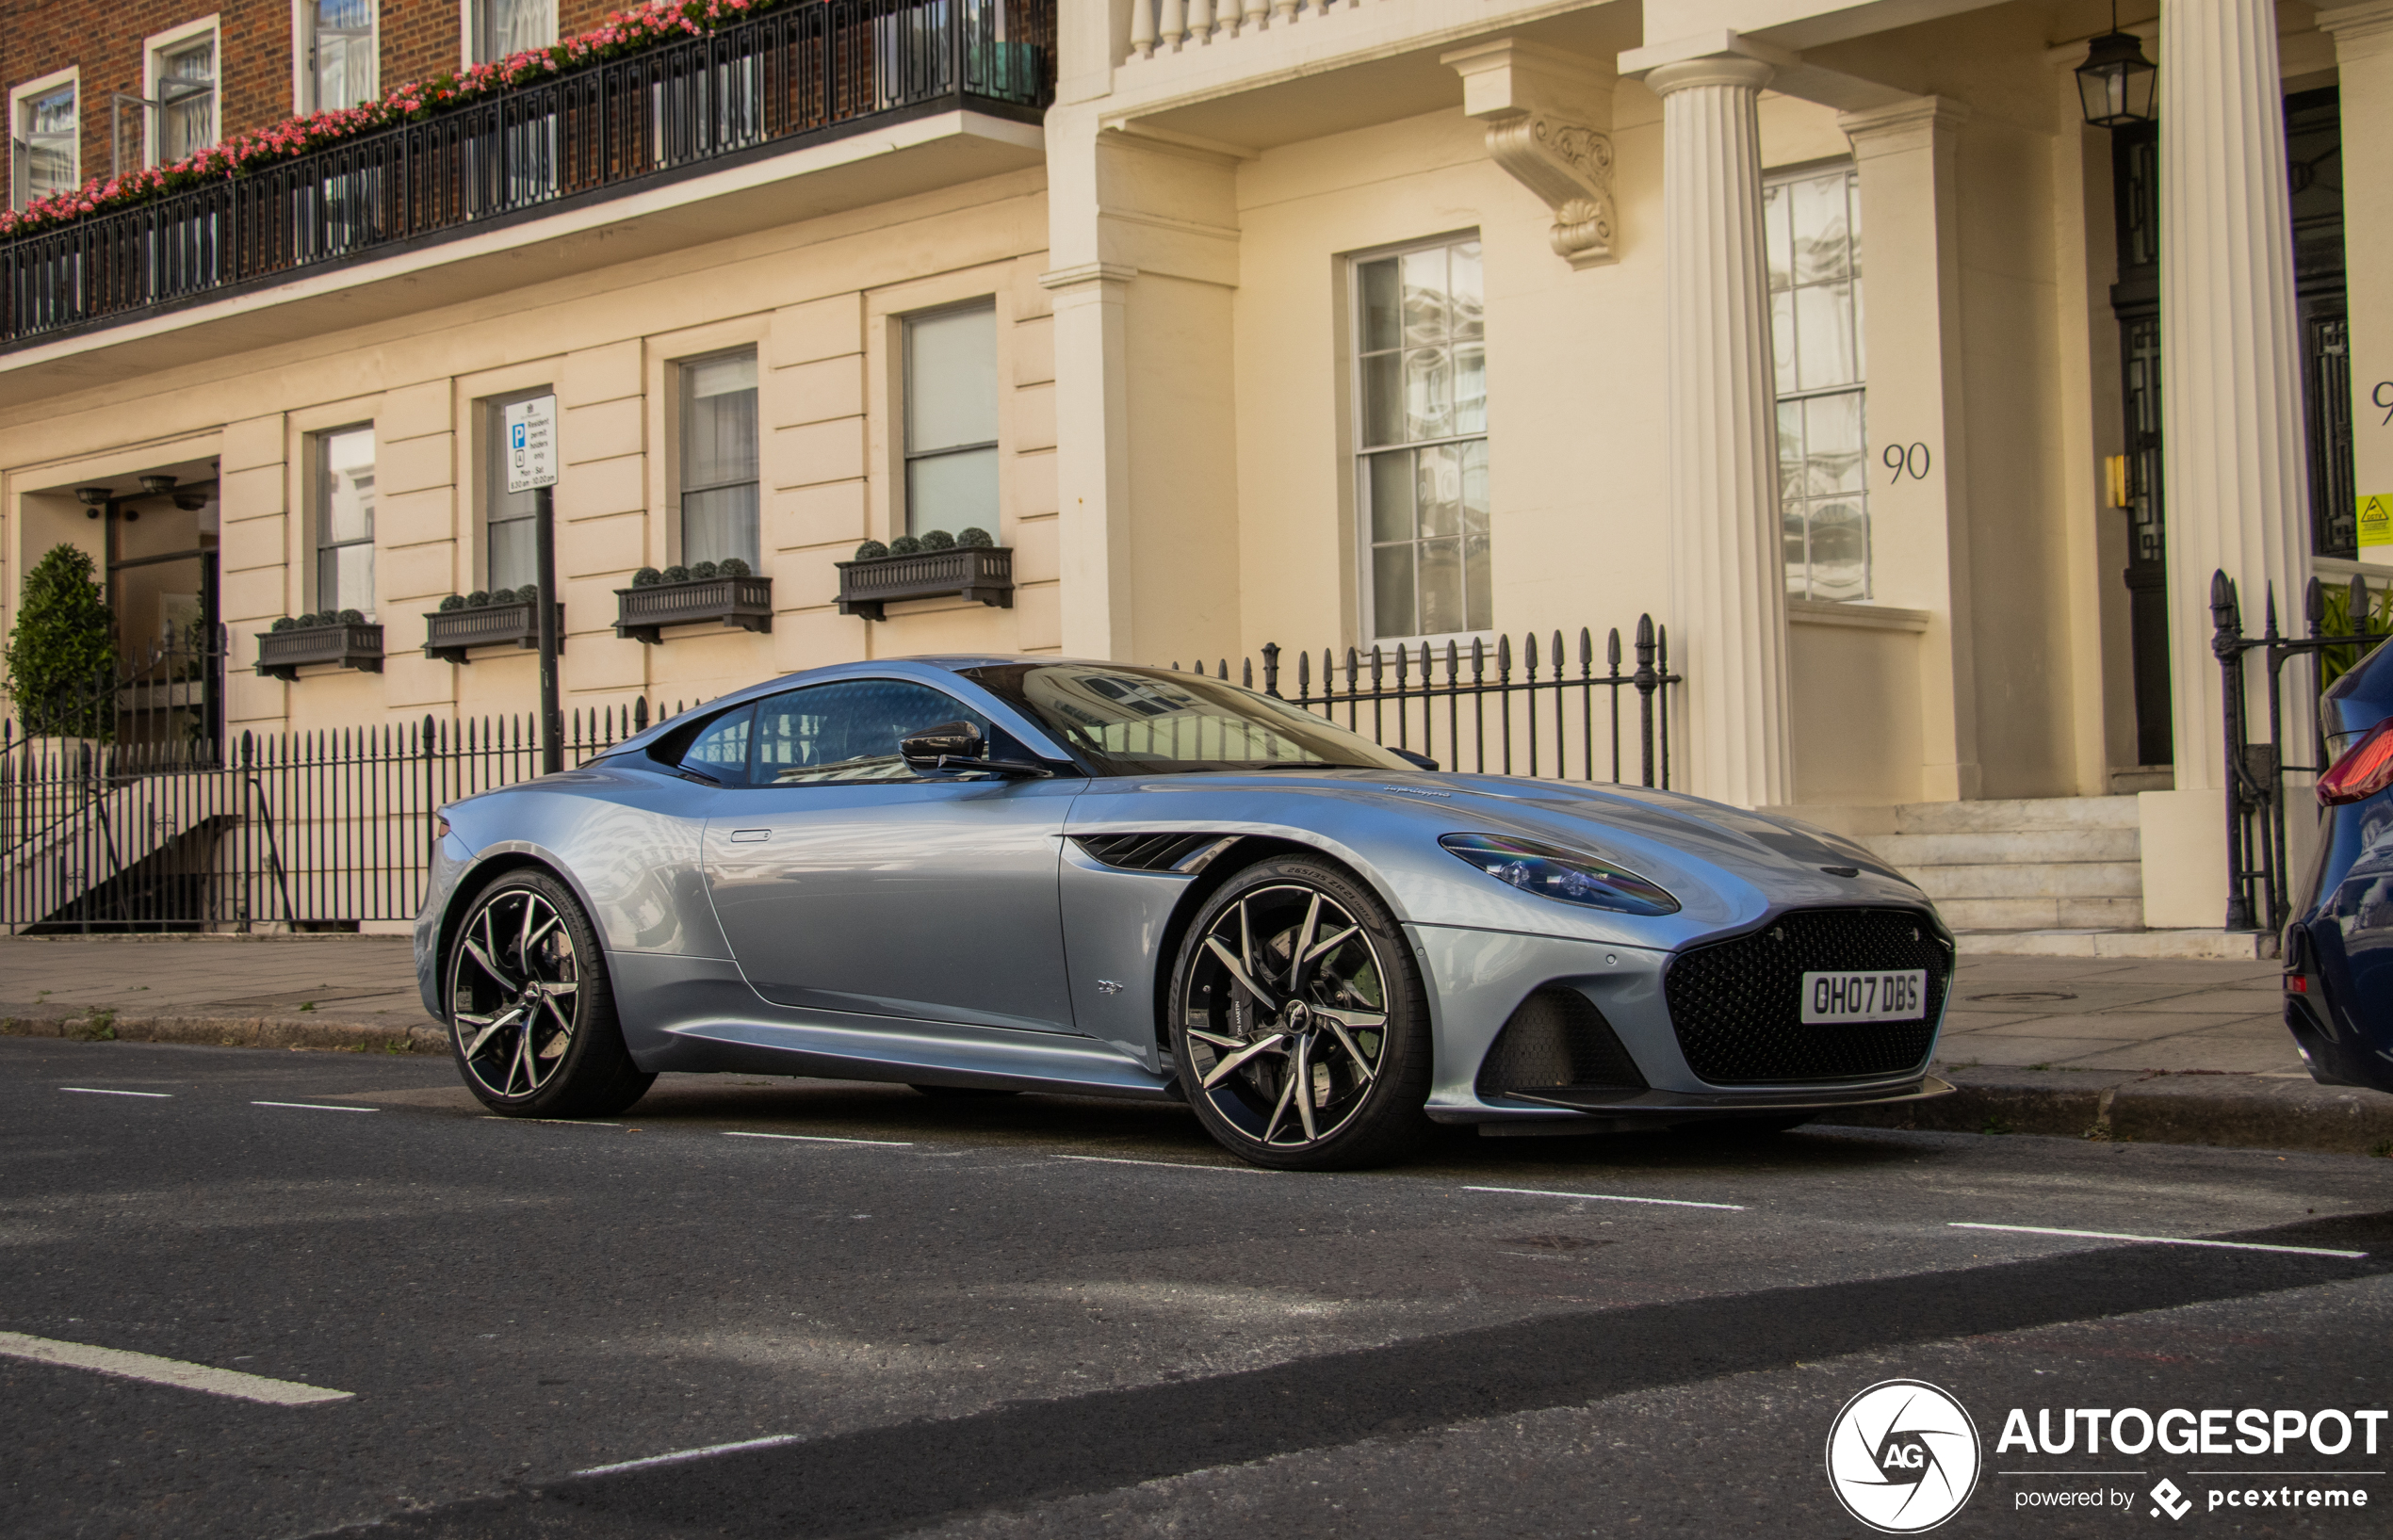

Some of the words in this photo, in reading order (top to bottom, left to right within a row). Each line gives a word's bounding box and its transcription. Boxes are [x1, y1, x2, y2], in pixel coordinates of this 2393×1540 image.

[528, 418, 549, 428] Resident
[515, 426, 524, 447] P
[530, 430, 546, 439] permit
[529, 441, 548, 449] holders
[533, 451, 545, 460] only
[1883, 442, 1929, 485] 90
[1287, 867, 1327, 882] 265/35
[1814, 977, 1877, 1014] OH07
[1882, 975, 1917, 1012] DBS
